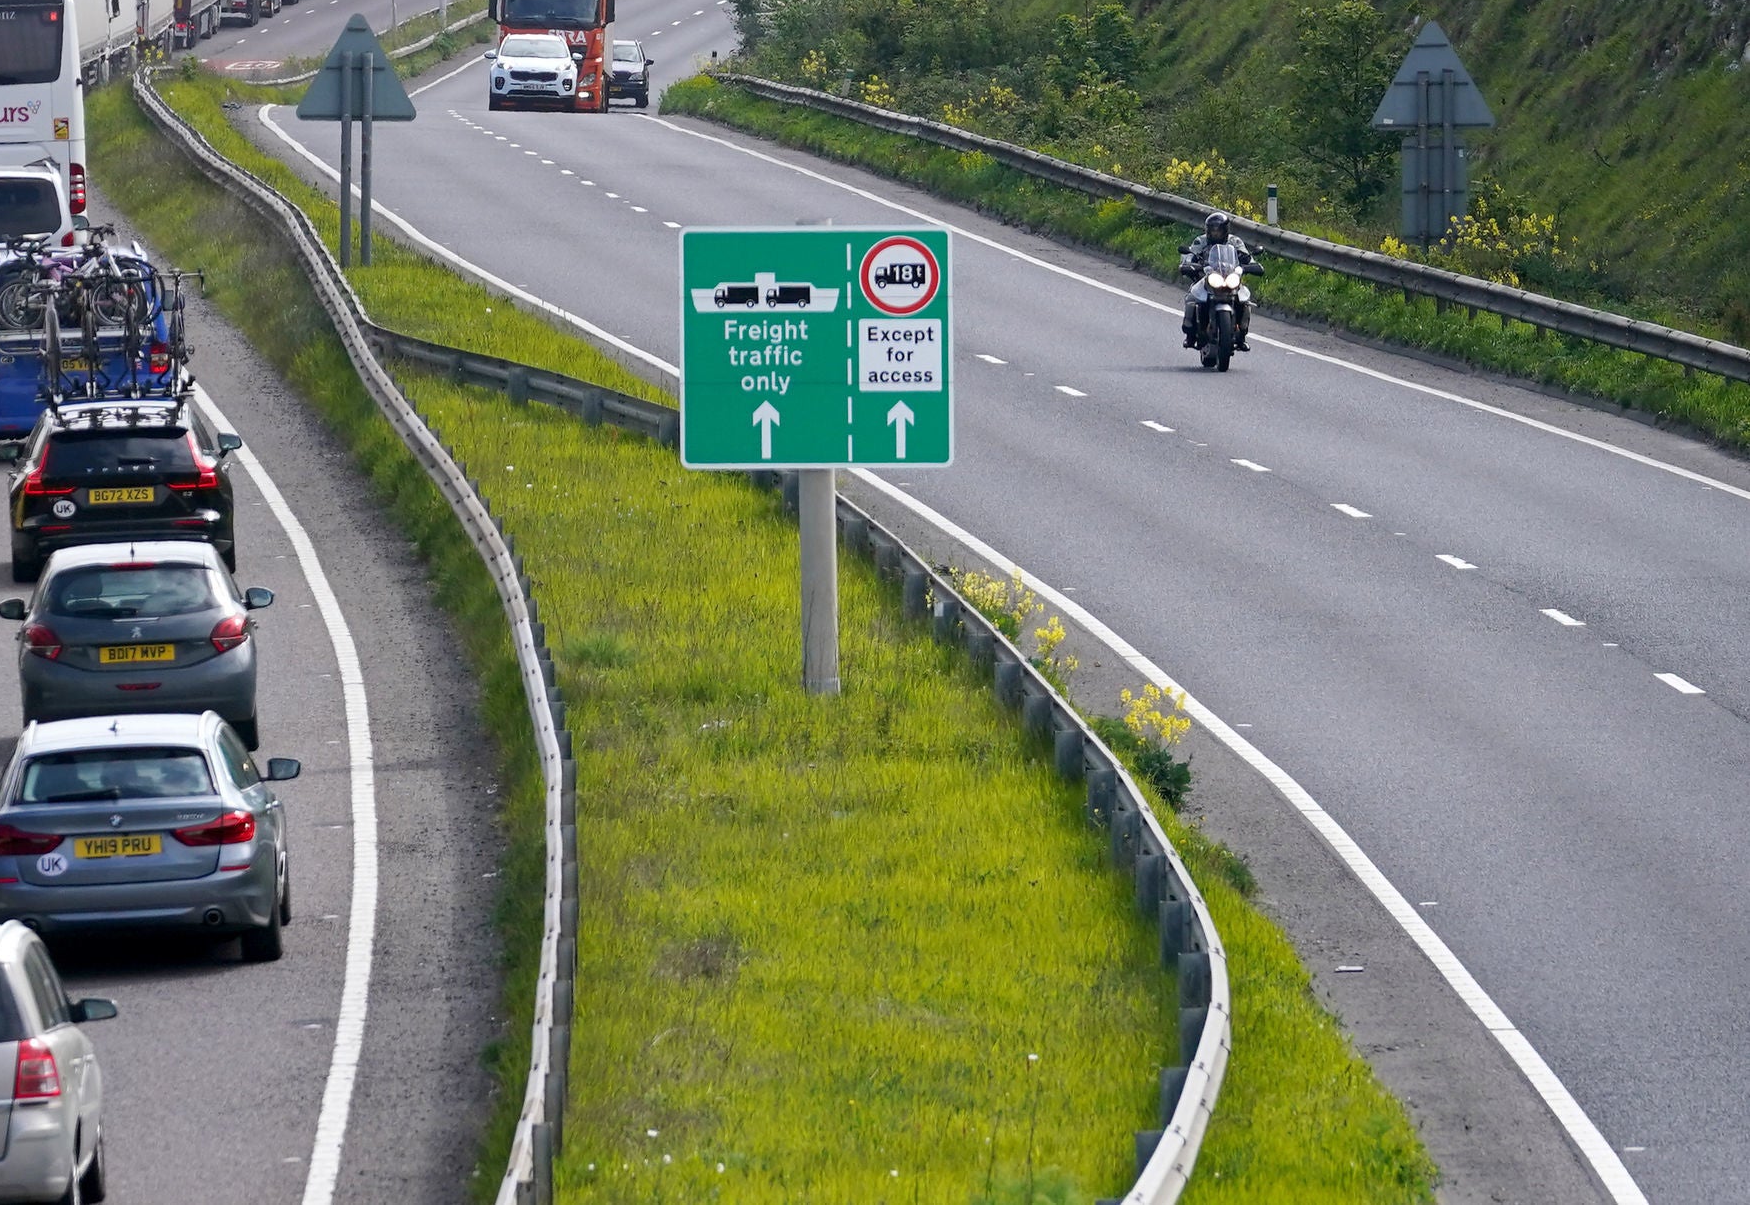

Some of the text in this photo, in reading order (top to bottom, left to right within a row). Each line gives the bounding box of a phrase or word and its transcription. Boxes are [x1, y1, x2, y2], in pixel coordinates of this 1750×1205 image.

[724, 319, 808, 344] Freight
[867, 326, 934, 345] Except
[729, 345, 803, 366] traffic
[887, 347, 914, 363] for
[741, 371, 791, 395] only
[868, 369, 933, 383] access
[94, 489, 149, 502] BG72 XZS
[56, 504, 71, 514] UK
[84, 836, 151, 854] YH19 PRU
[41, 858, 61, 872] UK
